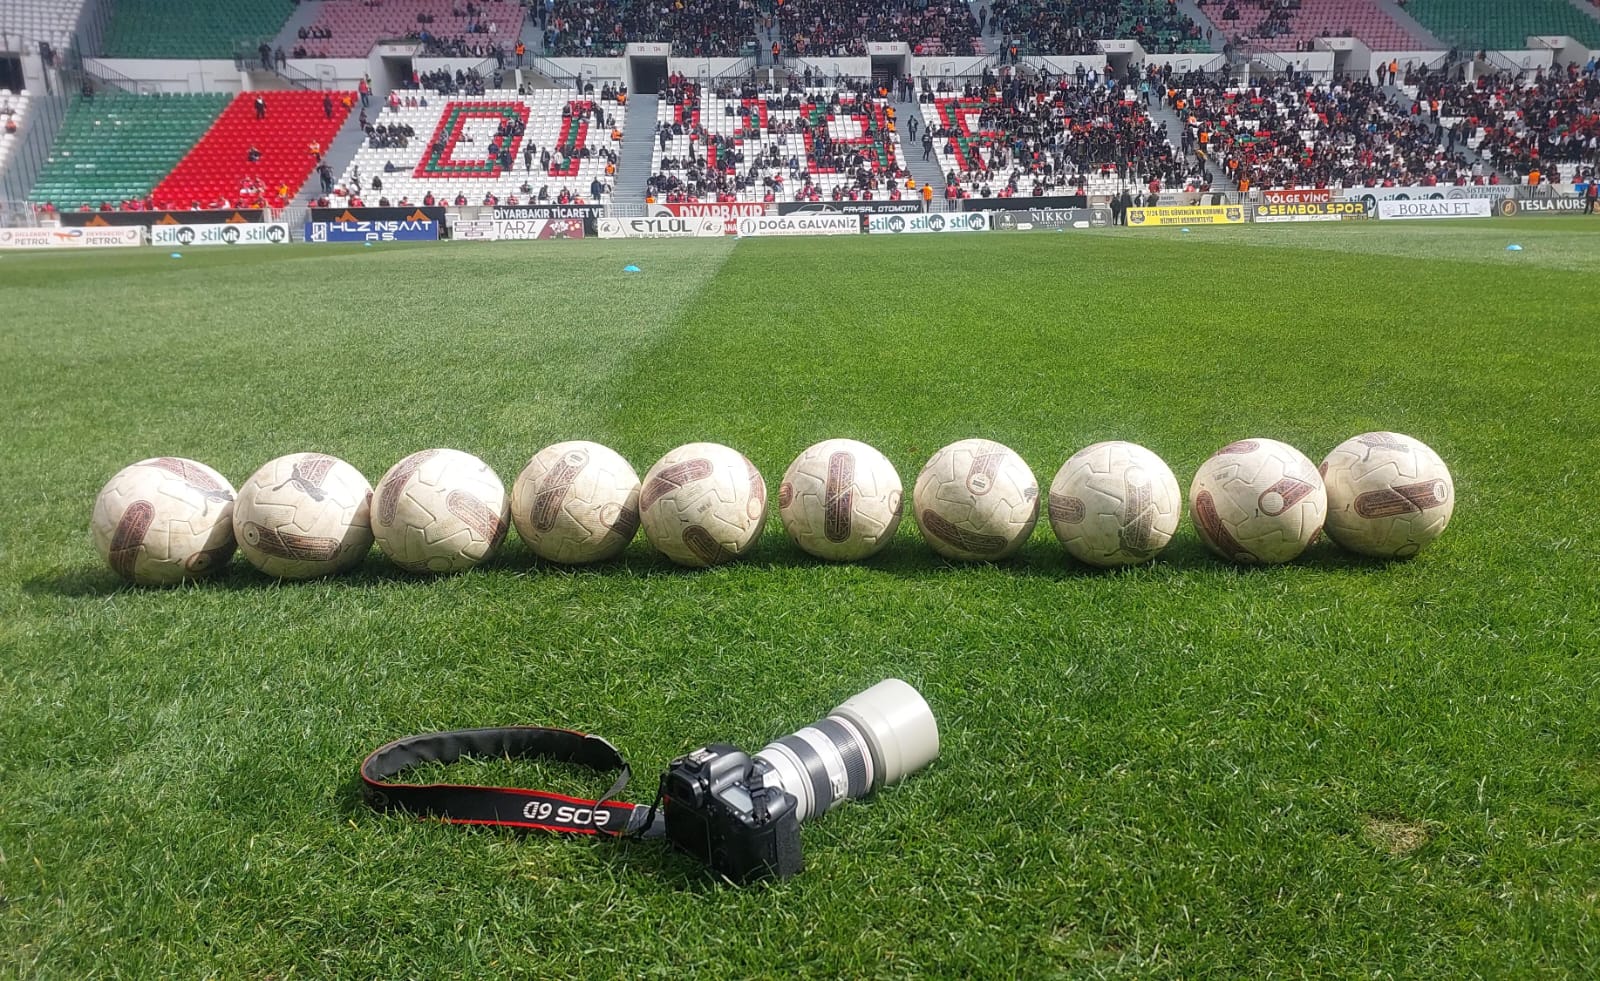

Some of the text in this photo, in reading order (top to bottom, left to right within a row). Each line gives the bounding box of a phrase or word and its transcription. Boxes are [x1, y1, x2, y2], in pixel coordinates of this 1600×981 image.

[1269, 204, 1323, 215] SEMBOL
[1326, 203, 1364, 214] SPOR
[1400, 202, 1471, 216] BORAN ET
[1518, 199, 1555, 211] TESLA
[494, 206, 604, 220] DİYARBAKIR TİCARET VE
[329, 221, 371, 232] HLZ
[496, 221, 537, 234] TARZ
[630, 218, 693, 233] EYLÜL
[758, 216, 857, 231] DOĞA GALVANİZ
[15, 237, 51, 246] PETROL
[86, 236, 124, 245] PETROL
[523, 801, 611, 826] EOS 6D
